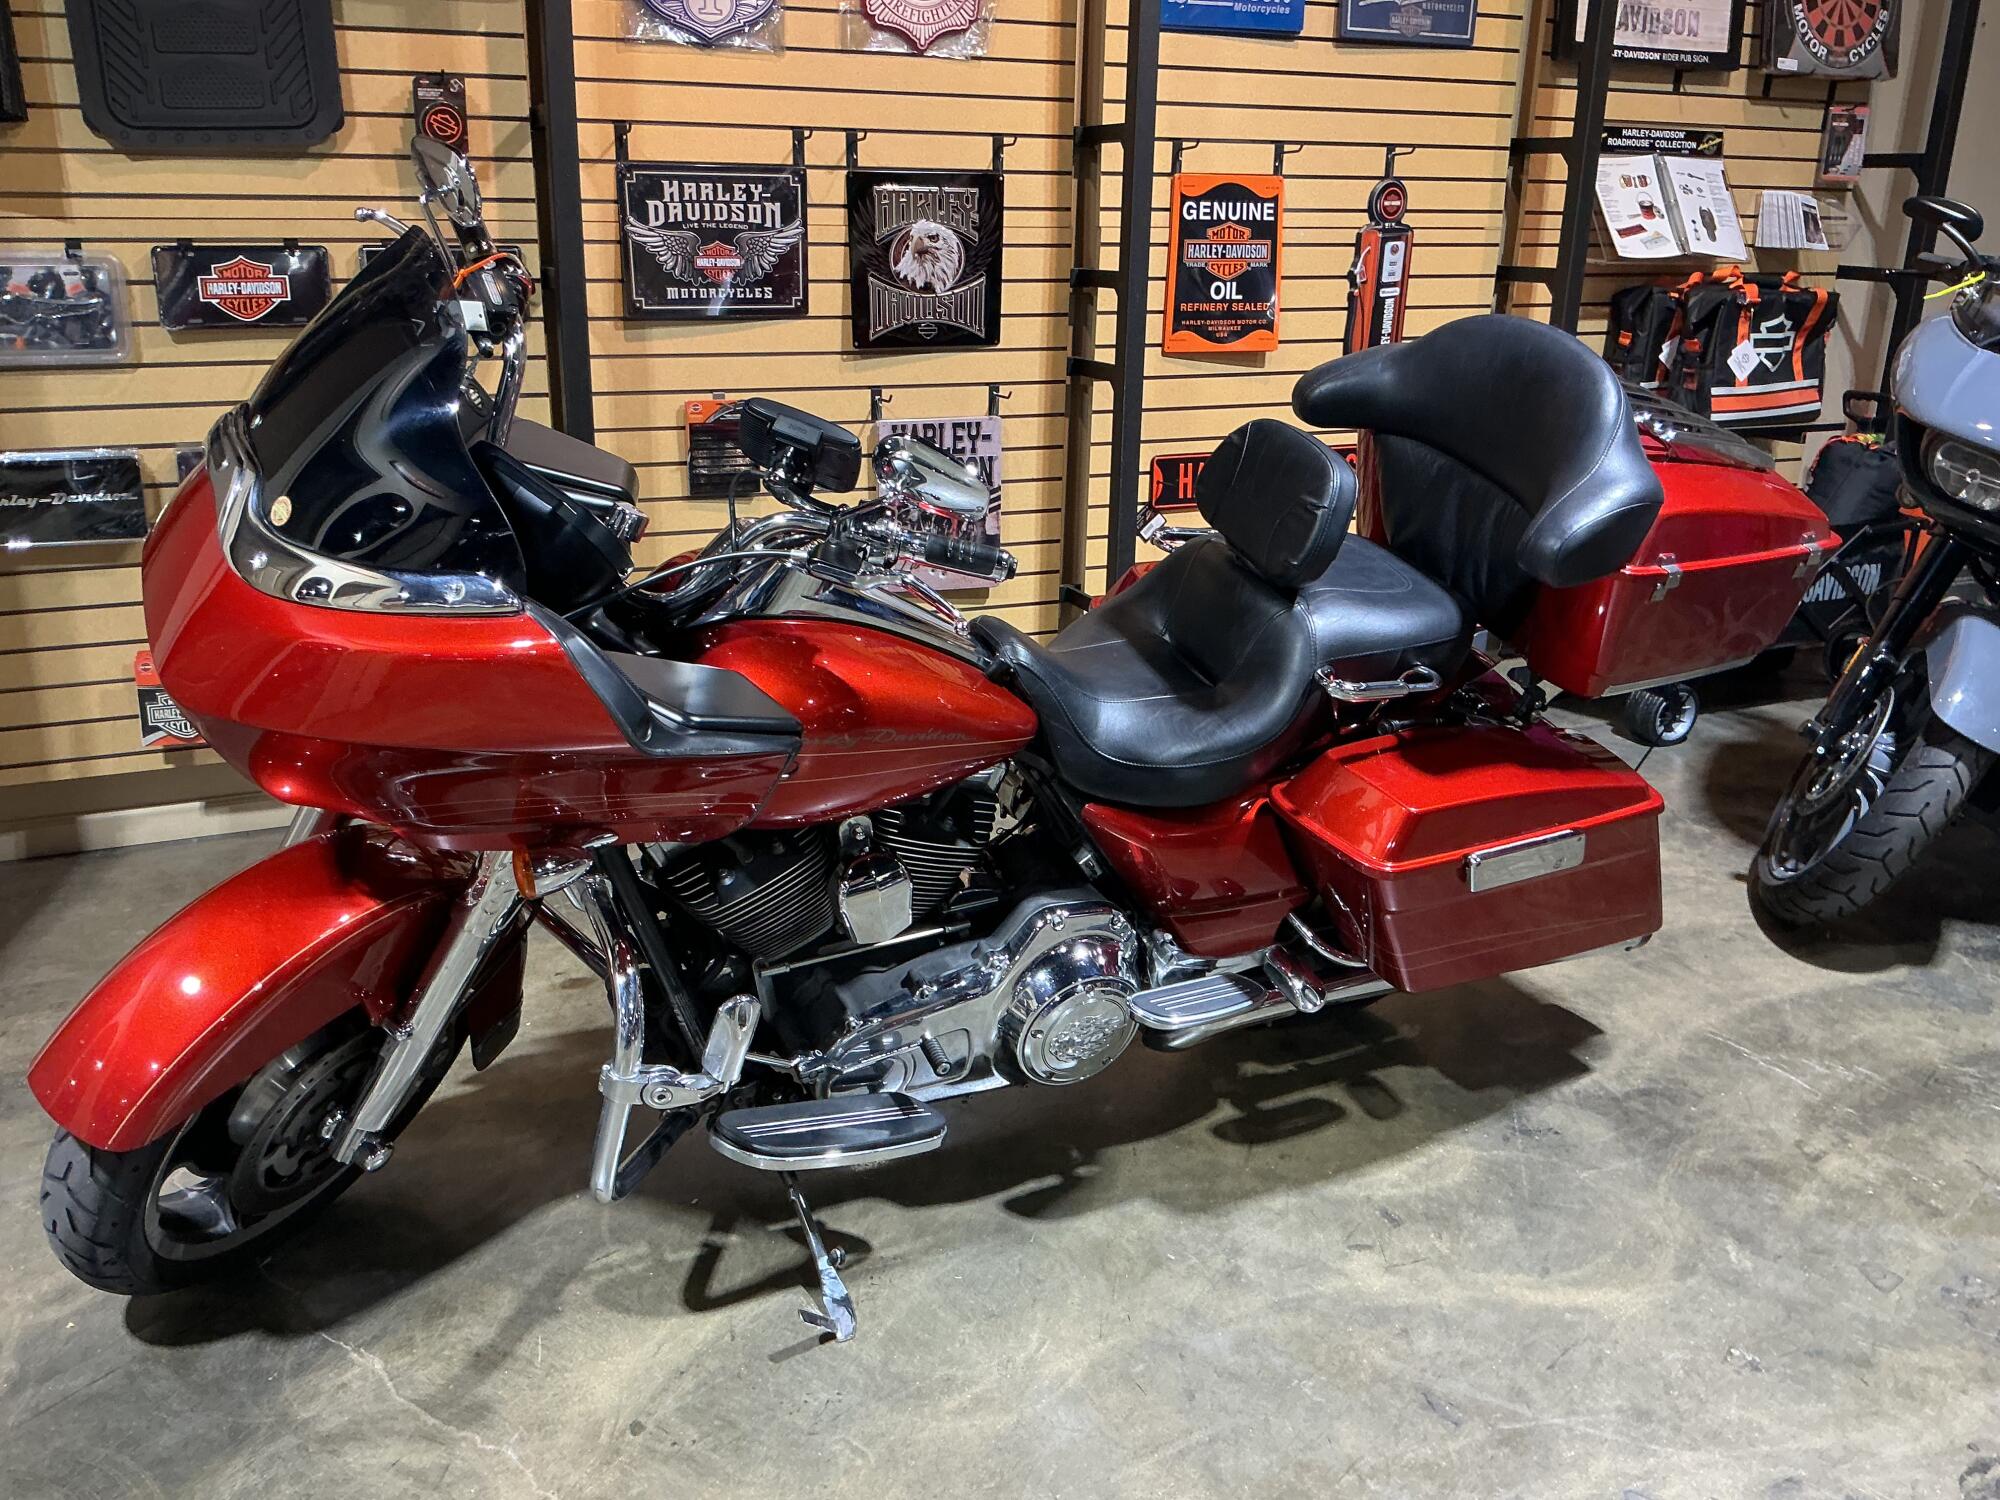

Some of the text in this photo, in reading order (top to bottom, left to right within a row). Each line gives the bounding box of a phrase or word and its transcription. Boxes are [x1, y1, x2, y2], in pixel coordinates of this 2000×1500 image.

[1233, 2, 1291, 15] Motorcycles
[1616, 4, 1700, 37] AVIDSON
[1794, 3, 1889, 62] MOTOR CYCLES
[1612, 49, 1660, 60] EY-DAVIDSON
[1680, 53, 1692, 62] PUB
[1654, 139, 1697, 150] COLLECTION
[661, 180, 771, 202] HARLEY-
[645, 200, 782, 229] DAVIDSON
[1182, 201, 1275, 221] GENUINE
[682, 222, 699, 230] LIVE
[1212, 224, 1246, 240] MOTOR
[1187, 244, 1268, 259] HARLEY-DAVIDSON
[222, 263, 264, 279] MOTOR
[1210, 262, 1245, 276] CYCLES
[207, 281, 283, 296] HARLEY-DAVIDSON
[666, 287, 773, 300] MOTORCYCLES
[1210, 281, 1243, 301] OIL
[226, 299, 266, 315] CYCLES
[868, 273, 986, 341] DAVIDSON
[1180, 302, 1270, 312] REFINERY SEALED
[1380, 297, 1395, 345] EY-DAVIDSON
[0, 489, 138, 509] rley-Davidson
